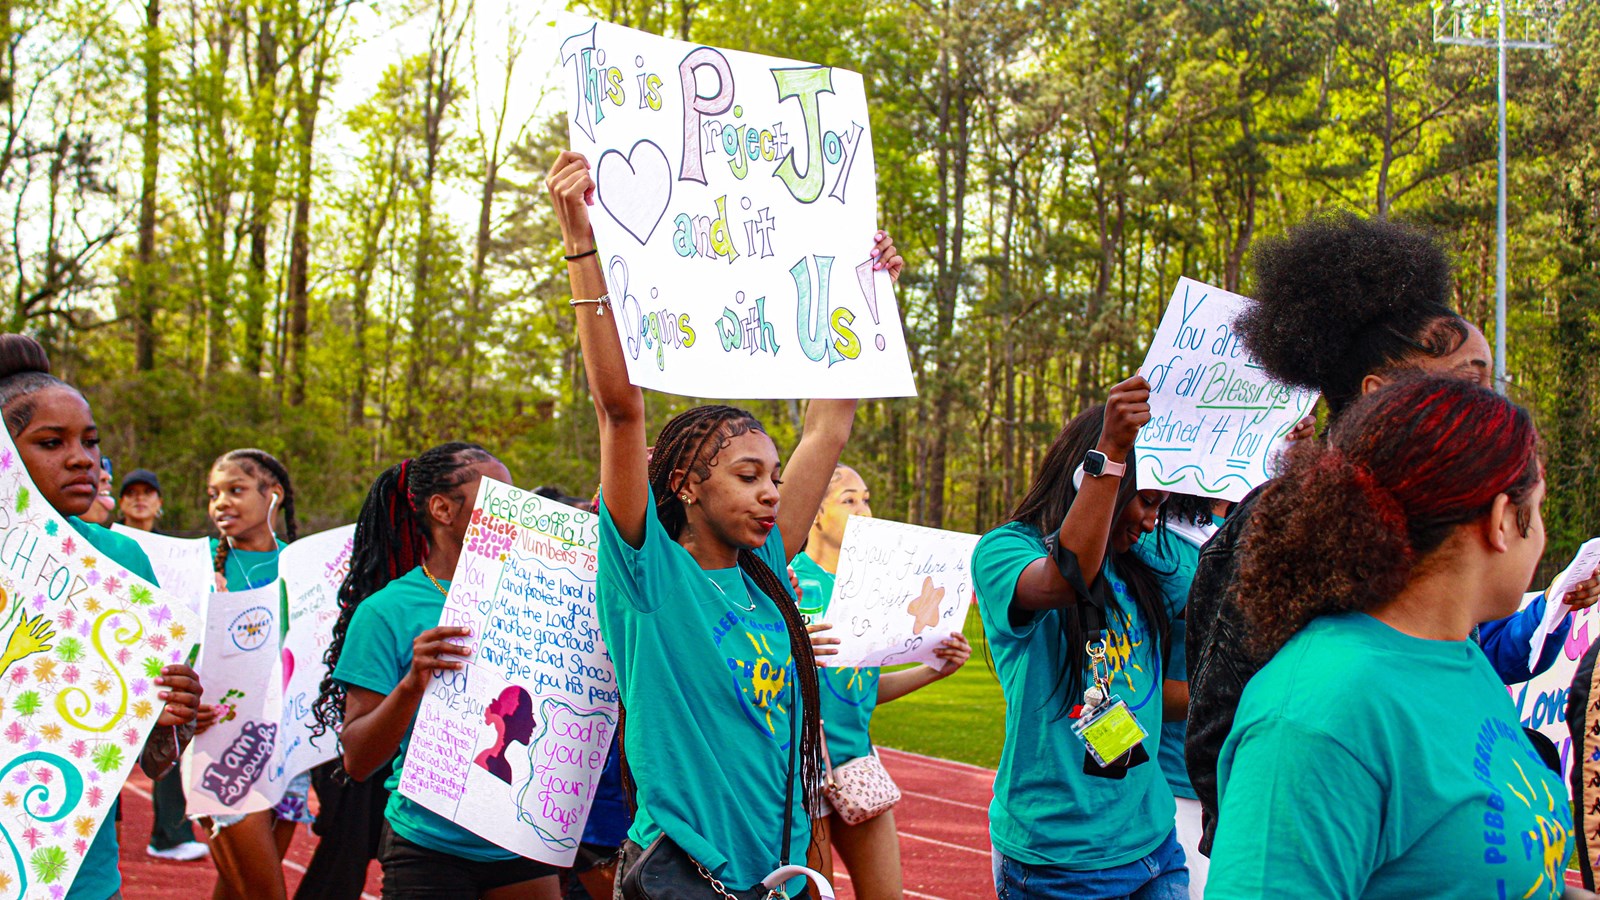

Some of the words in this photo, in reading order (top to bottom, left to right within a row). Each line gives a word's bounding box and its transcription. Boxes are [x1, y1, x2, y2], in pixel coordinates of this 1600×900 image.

[560, 22, 626, 143] This
[635, 55, 664, 111] is
[678, 46, 789, 186] Project
[769, 65, 864, 204] Joy
[672, 194, 740, 264] and
[740, 196, 776, 259] it
[608, 254, 697, 371] Begins
[714, 290, 781, 357] with
[1172, 284, 1208, 351] You
[1211, 324, 1244, 358] are
[1147, 355, 1183, 395] of
[1176, 363, 1208, 397] all
[1200, 361, 1291, 424] Blessings
[1210, 414, 1232, 454] 4
[1231, 416, 1264, 458] You
[482, 479, 518, 523] Keep
[467, 524, 480, 537] in
[515, 529, 577, 565] Numbers
[34, 553, 89, 612] FOR
[451, 583, 479, 609] Got
[502, 577, 523, 596] and
[525, 585, 564, 607] protect
[534, 568, 556, 591] the
[491, 616, 514, 633] and
[515, 622, 532, 641] be
[533, 628, 595, 654] gracious
[522, 605, 542, 623] the
[546, 610, 576, 630] Lord
[480, 646, 504, 667] and
[505, 657, 531, 681] give
[534, 670, 561, 695] you
[565, 674, 584, 695] his
[514, 641, 533, 661] the
[535, 650, 565, 669] Lord
[205, 766, 230, 785] I
[224, 734, 256, 769] am
[223, 726, 276, 804] enough
[534, 739, 583, 773] you
[538, 771, 584, 802] your
